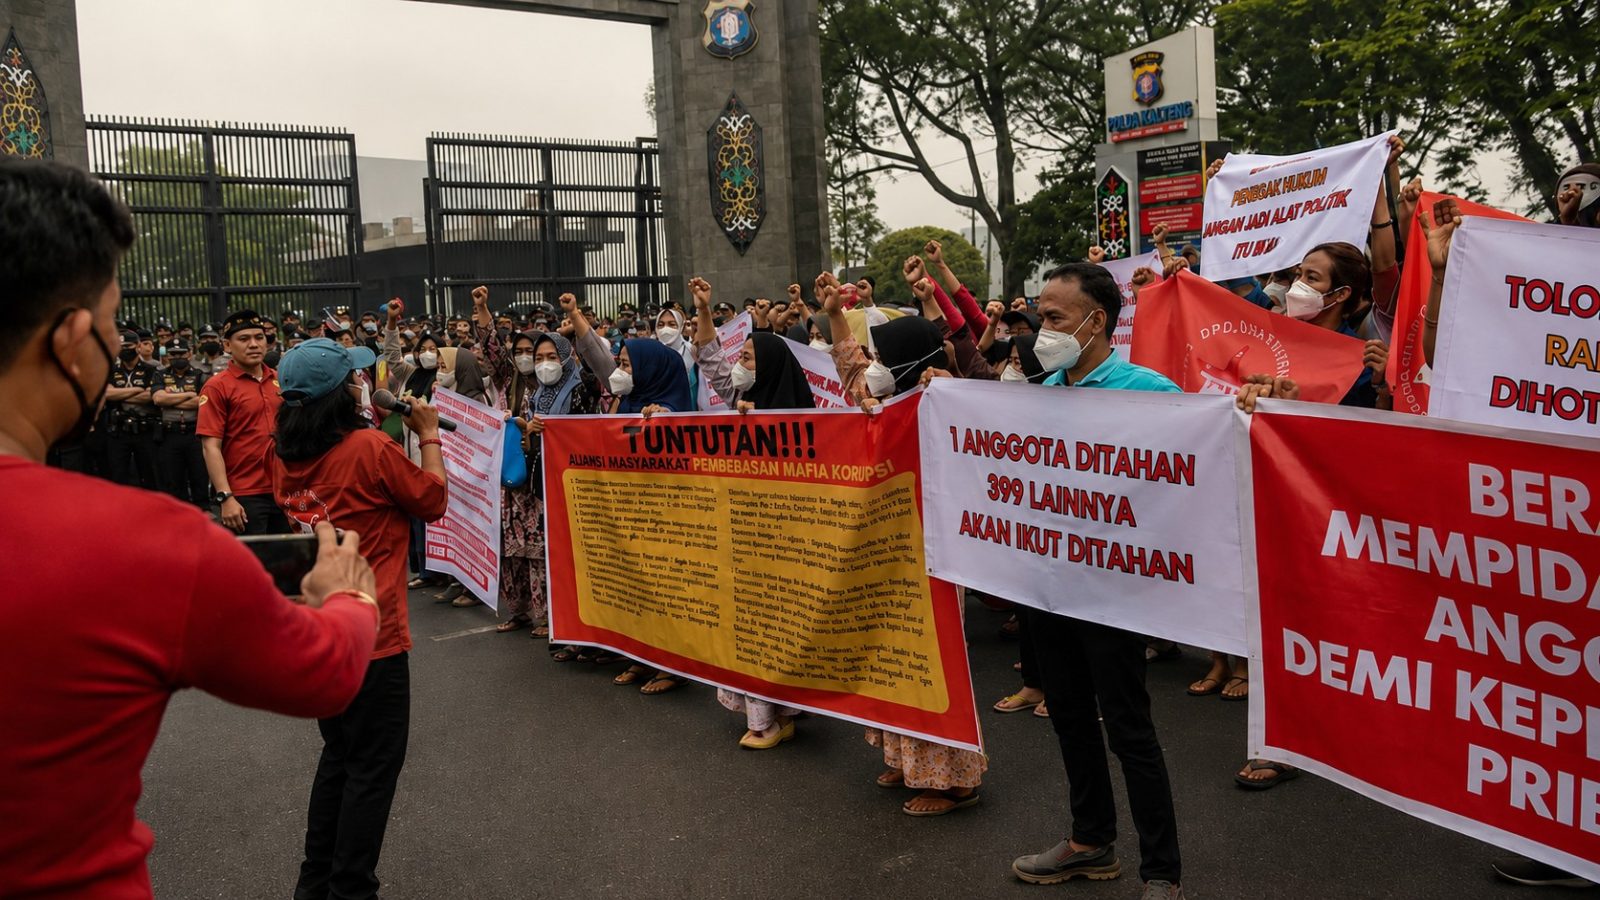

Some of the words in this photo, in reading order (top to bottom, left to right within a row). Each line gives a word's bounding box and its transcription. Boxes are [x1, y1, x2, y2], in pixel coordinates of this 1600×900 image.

[1140, 101, 1193, 126] KALTENG
[1231, 178, 1282, 208] PENEGAK
[1282, 166, 1328, 194] HUKUM
[1244, 209, 1271, 231] JADI
[1270, 203, 1303, 226] ALAT
[1301, 189, 1352, 217] POLITIK
[1505, 275, 1600, 320] TOLO
[1545, 334, 1600, 373] RA
[1490, 375, 1600, 424] DIHOT
[623, 422, 816, 459] TUNTUTAN!!!
[950, 426, 959, 453] 1
[963, 428, 1070, 470] ANGGOTA
[1076, 441, 1196, 486] DITAHAN
[609, 456, 690, 471] MASYARAKAT
[693, 457, 779, 476] PEMBEBASAN
[783, 462, 828, 479] MAFIA
[832, 459, 896, 482] KORUPSI
[987, 473, 1023, 505] 399
[1030, 481, 1137, 527] LAINNYA
[1468, 463, 1600, 536] BER
[960, 510, 1011, 546] AKAN
[1016, 522, 1062, 557] IKUT
[1068, 534, 1195, 584] DITAHAN
[1283, 627, 1433, 711] DEMI
